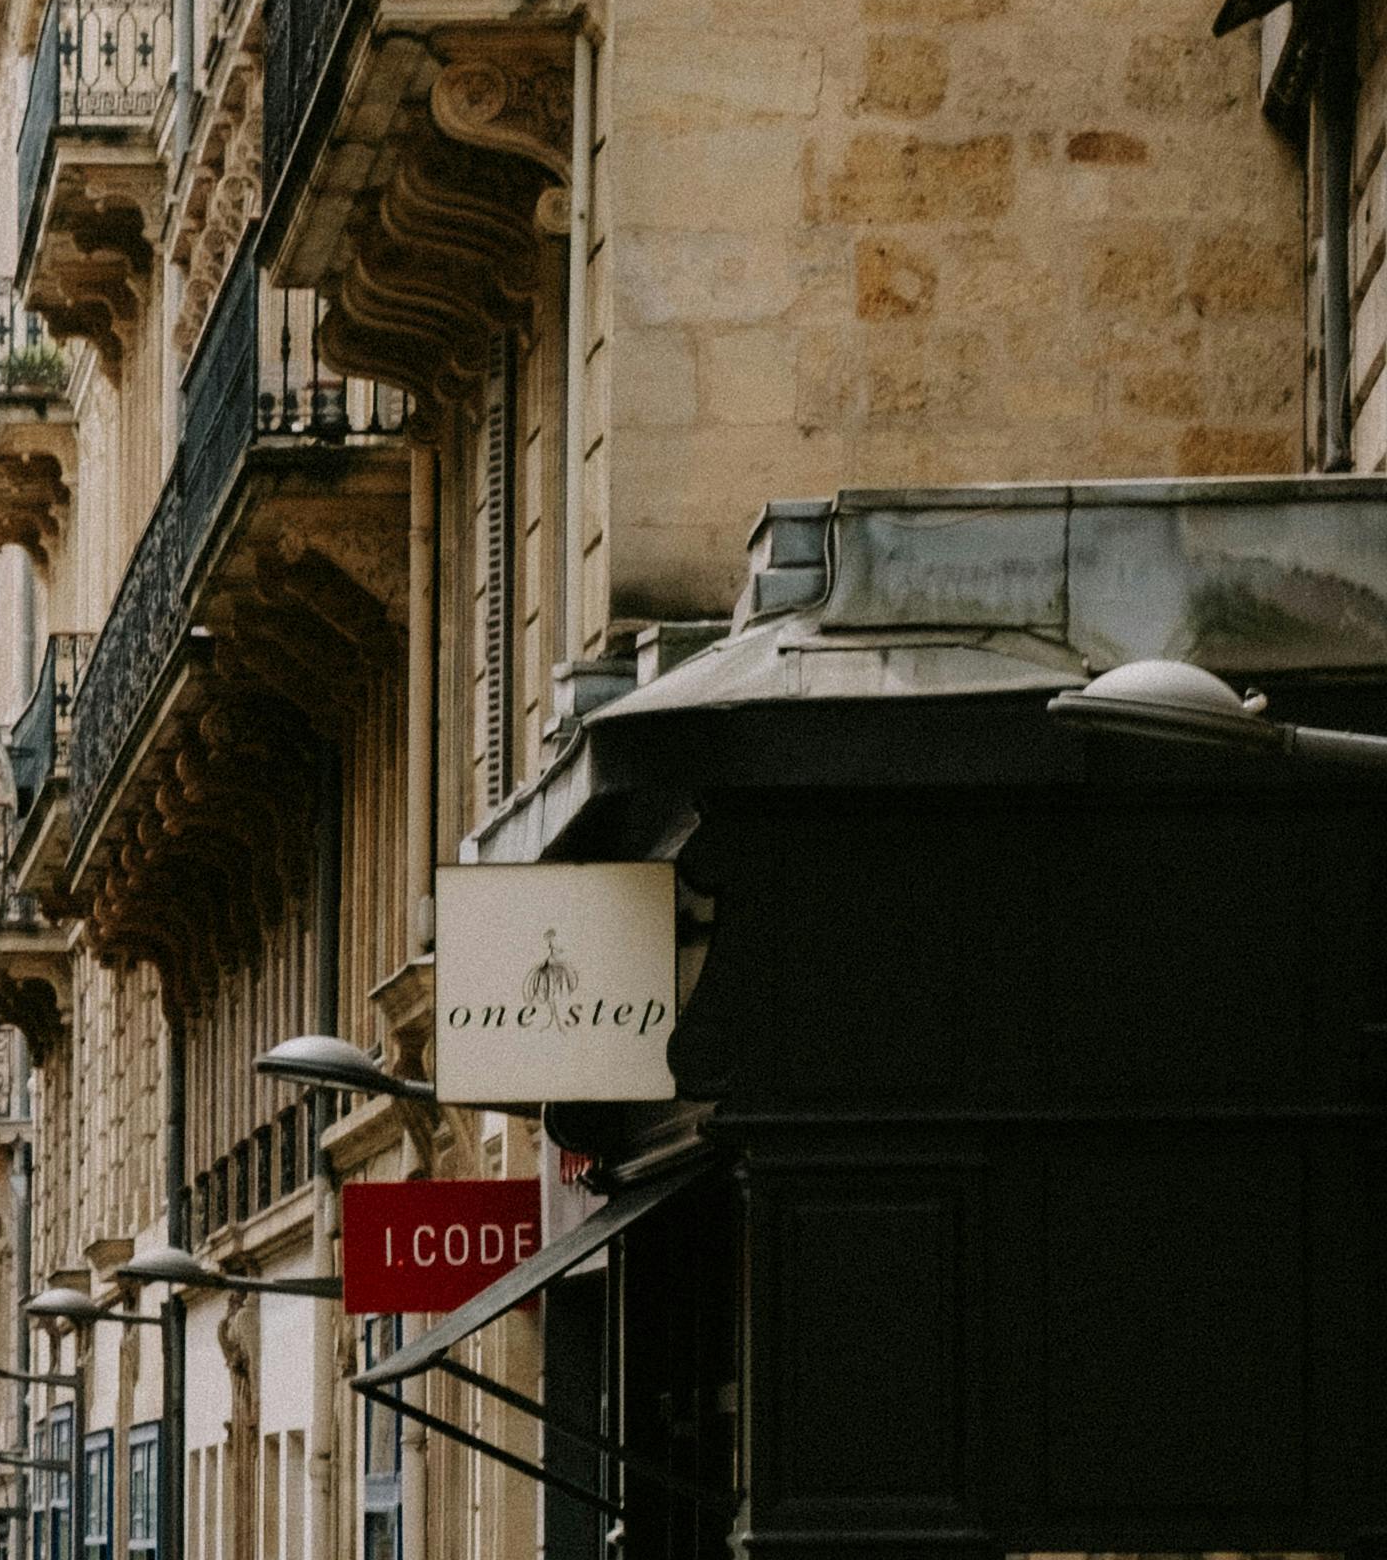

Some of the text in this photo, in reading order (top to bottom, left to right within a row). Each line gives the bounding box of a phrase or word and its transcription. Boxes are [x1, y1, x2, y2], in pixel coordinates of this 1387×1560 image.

[448, 998, 667, 1036] one step
[384, 1222, 535, 1268] I.CODE
